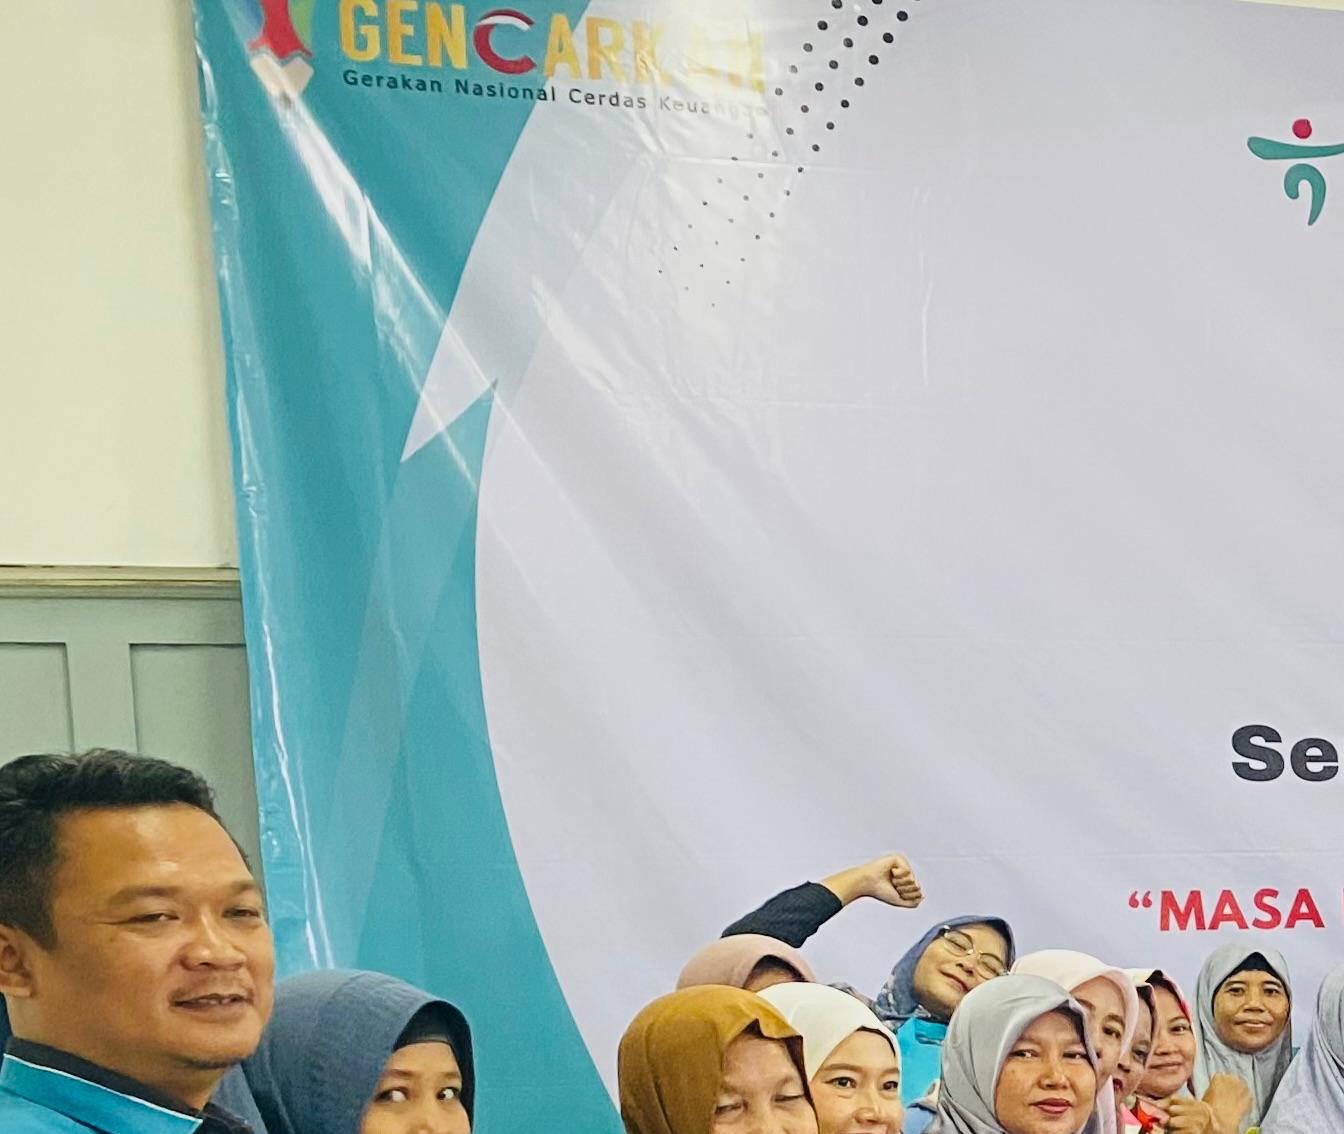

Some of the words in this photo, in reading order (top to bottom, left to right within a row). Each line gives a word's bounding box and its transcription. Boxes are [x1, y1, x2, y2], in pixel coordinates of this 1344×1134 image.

[343, 69, 443, 94] Gerakan
[455, 79, 557, 103] Nasional
[569, 88, 647, 110] Cerdas
